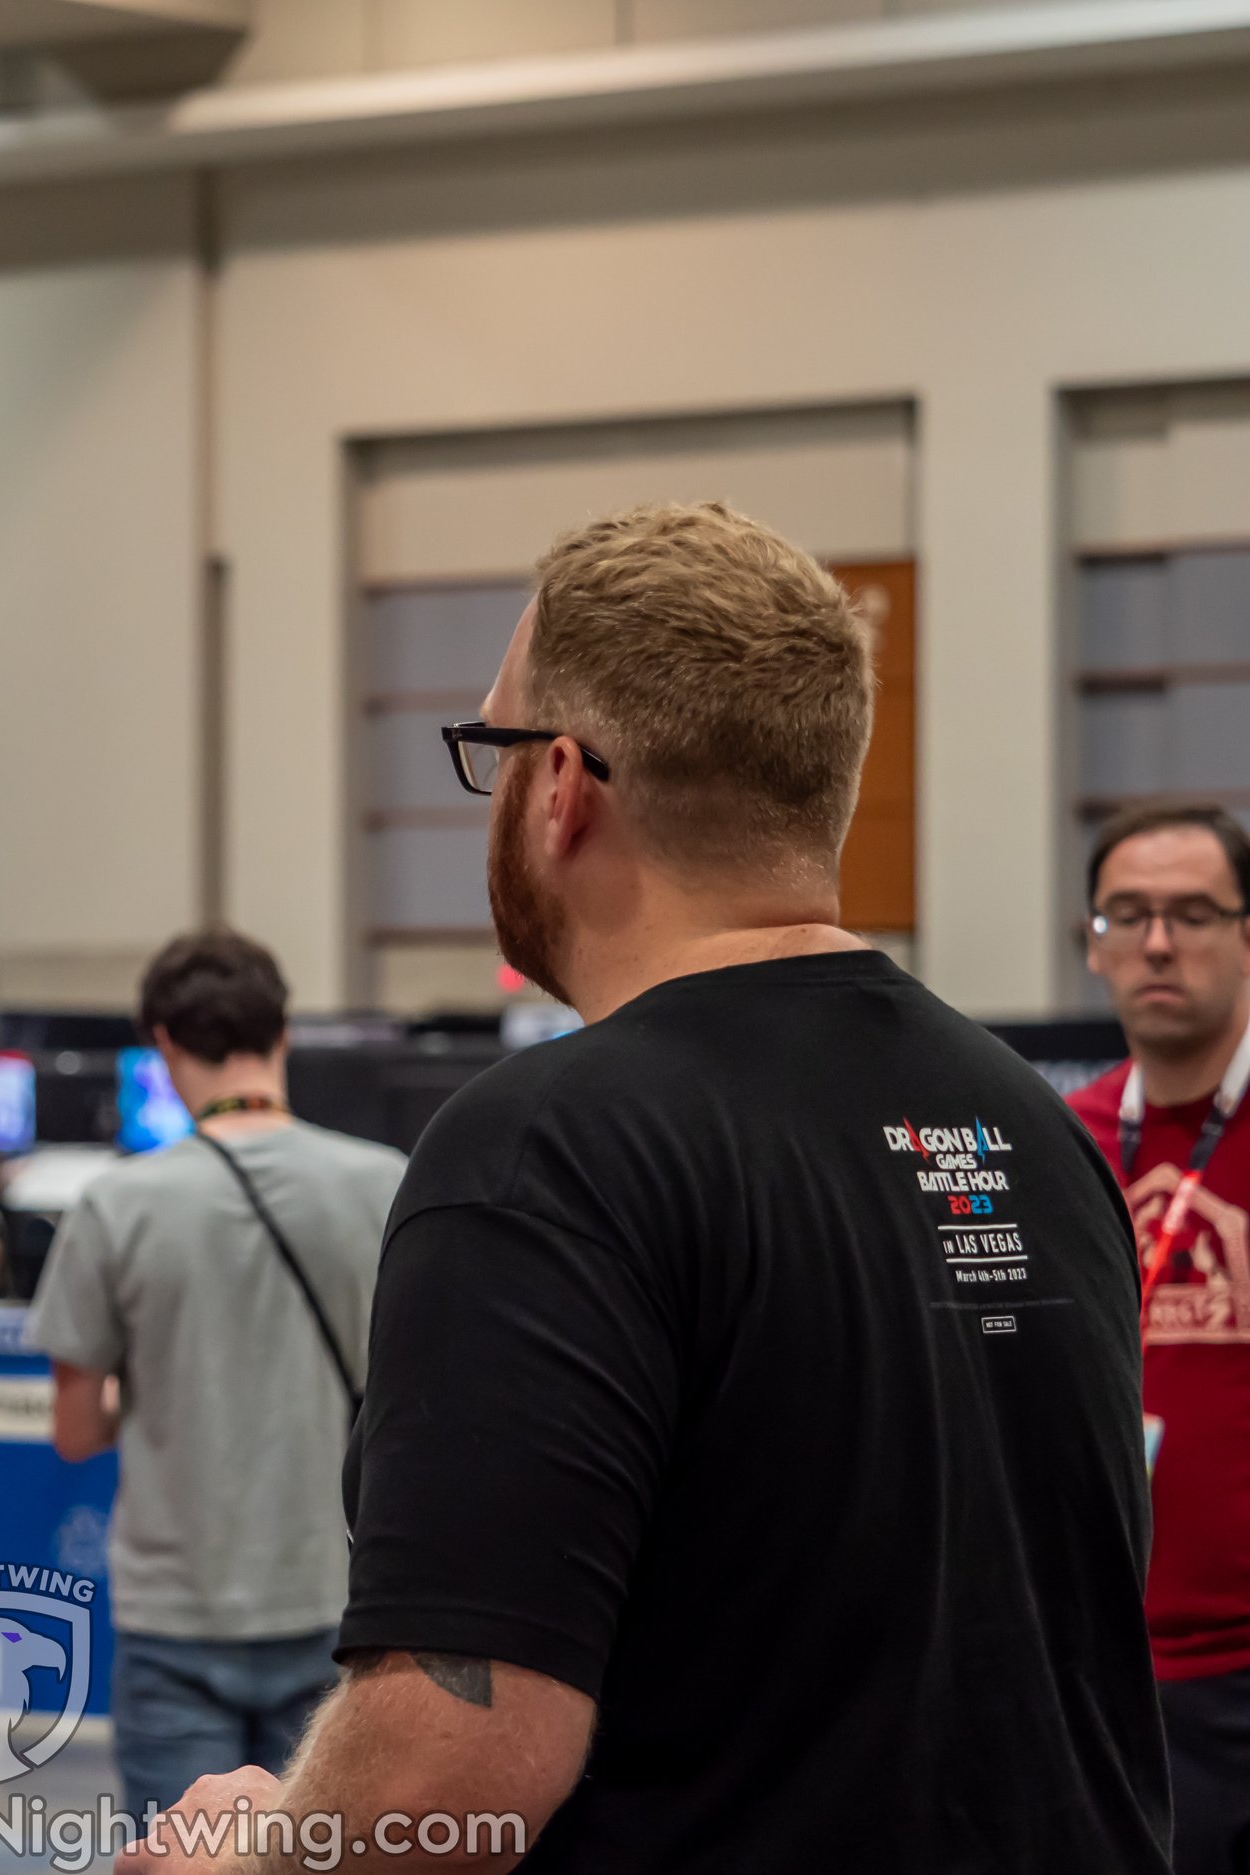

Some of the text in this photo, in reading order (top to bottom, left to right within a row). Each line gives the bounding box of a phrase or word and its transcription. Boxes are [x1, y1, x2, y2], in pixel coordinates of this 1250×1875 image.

[882, 1115, 1012, 1163] DRAGON BALL
[935, 1153, 978, 1170] GAMES
[916, 1170, 1010, 1192] BATTLE HOUR
[947, 1195, 994, 1215] 2023
[942, 1232, 1023, 1254] IN LAS VEGAS
[955, 1270, 977, 1282] March
[1007, 1267, 1028, 1281] 2023
